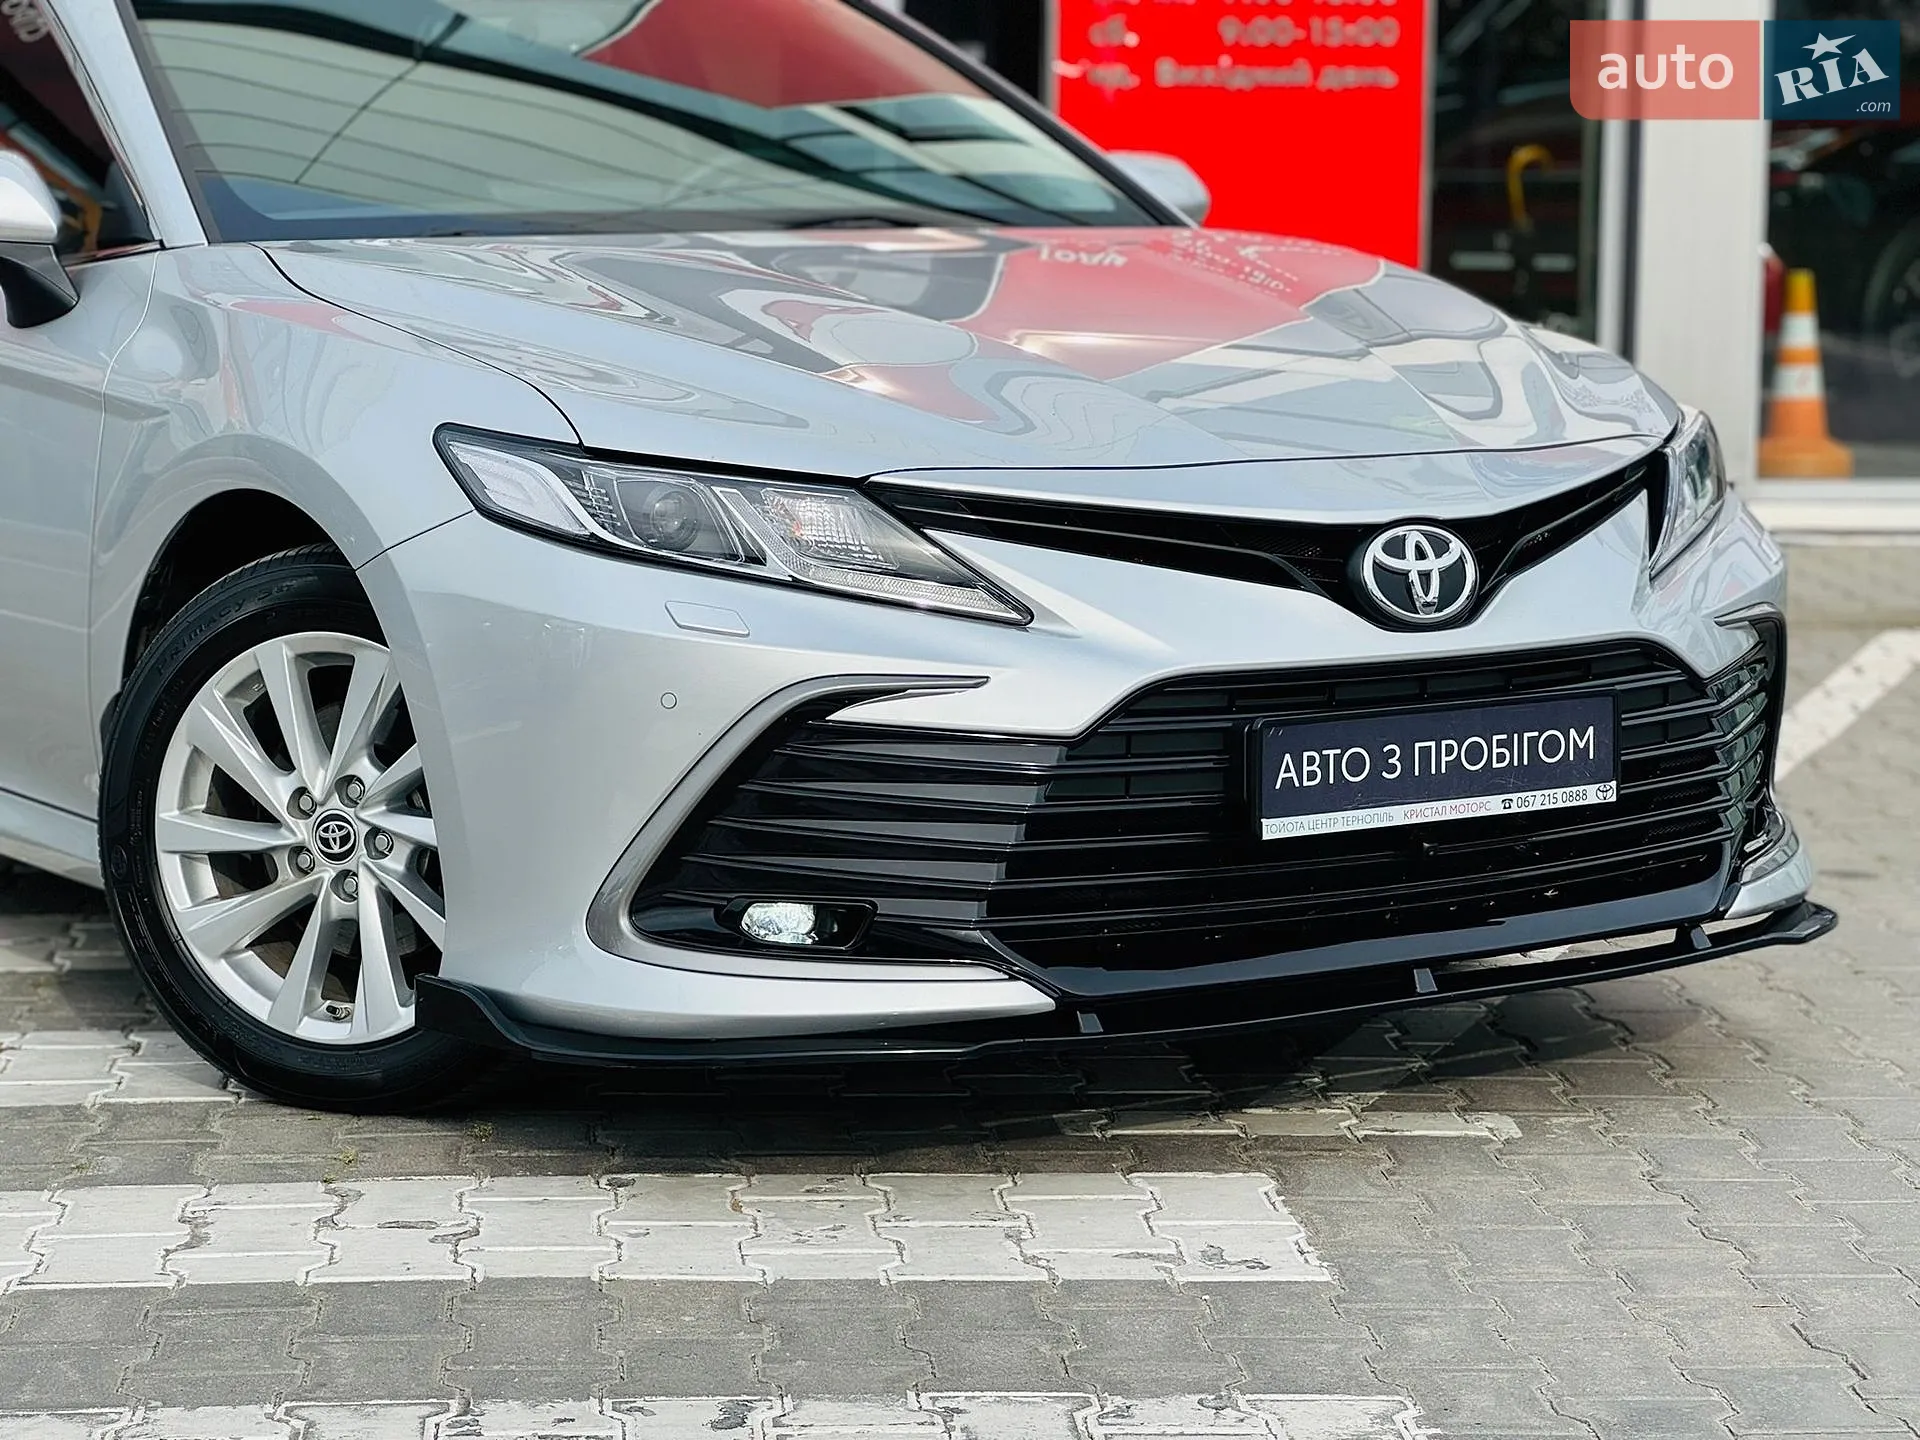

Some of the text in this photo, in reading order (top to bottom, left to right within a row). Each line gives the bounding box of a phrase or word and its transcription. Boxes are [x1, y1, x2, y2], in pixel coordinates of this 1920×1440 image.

[1275, 746, 1371, 790] АВТО
[1413, 726, 1595, 776] ПРОБІГОМ
[1516, 789, 1588, 809] 067 215 0888
[1264, 801, 1491, 835] ТОЙОТА ЦЕНТР ТЕРНОПІЛЬ КРИСТАЛ МОТОРС
